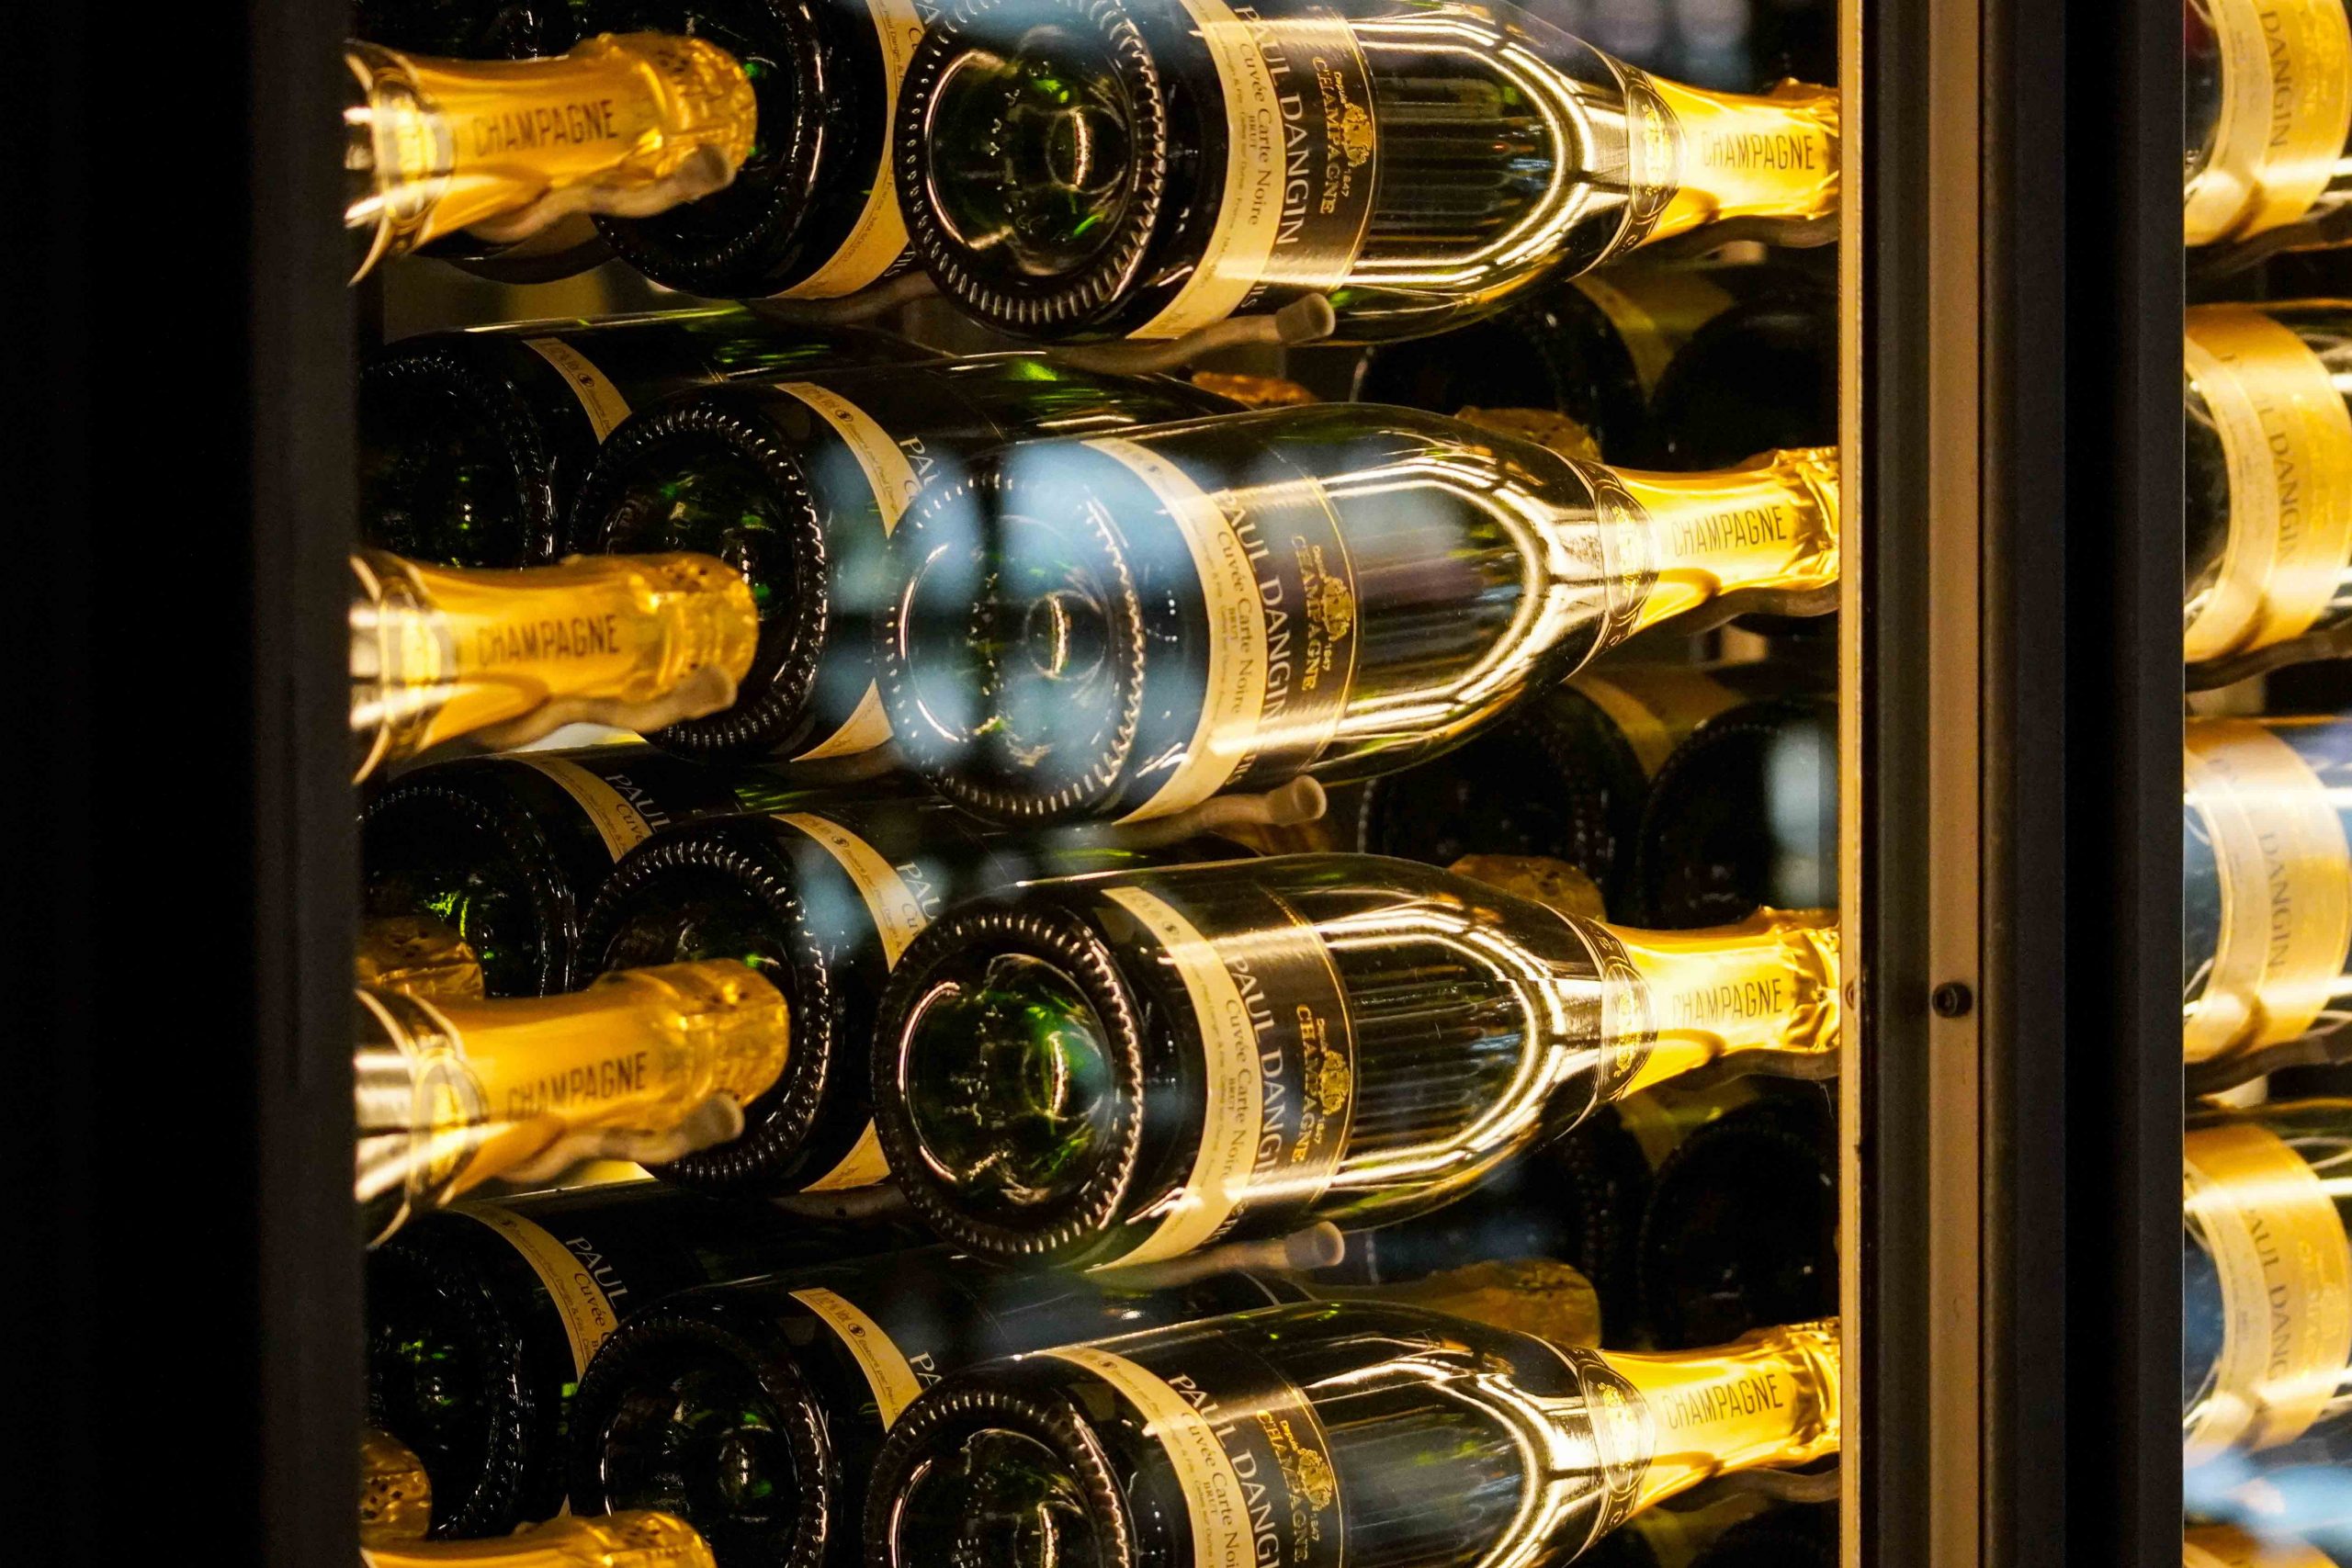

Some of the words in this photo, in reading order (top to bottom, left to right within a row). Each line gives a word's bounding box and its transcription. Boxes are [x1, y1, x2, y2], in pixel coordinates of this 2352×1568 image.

[1240, 43, 1267, 102] Cuvée
[2261, 9, 2292, 149] DANGIN
[473, 99, 619, 154] CHAMPAGNE
[1234, 6, 1291, 87] PAUL
[1276, 92, 1309, 245] DANGIN
[1258, 107, 1272, 164] Carte
[1312, 55, 1341, 215] CHAMPAGNE
[1702, 130, 1816, 172] CHAMPAGNE
[1247, 169, 1272, 226] Noire
[1217, 530, 1247, 592] Cuvée
[1670, 505, 1787, 558] CHAMPAGNE
[476, 613, 622, 669] CHAMPAGNE
[1237, 597, 1252, 653] Carte
[1258, 574, 1292, 725] DANGIN
[1230, 658, 1254, 714] Noire
[2258, 831, 2292, 969] DANGIN
[1223, 954, 1275, 1043] PAUL
[1672, 977, 1783, 1029] CHAMPAGNE
[506, 1051, 650, 1121] CHAMPAGNE
[1225, 998, 1250, 1063] Cuvée
[1238, 1067, 1252, 1123] Carte
[565, 1235, 628, 1309] PAUL
[572, 1270, 607, 1327] Cuvée
[1661, 1373, 1784, 1430] CHAMPAGNE
[1168, 1373, 1237, 1450] PAUL
[1231, 1448, 1282, 1568] DANGI
[1180, 1410, 1217, 1468] Cuvée
[1212, 1472, 1234, 1527] Carte
[1223, 1530, 1240, 1568] Noi
[1203, 1481, 1219, 1514] BRUT
